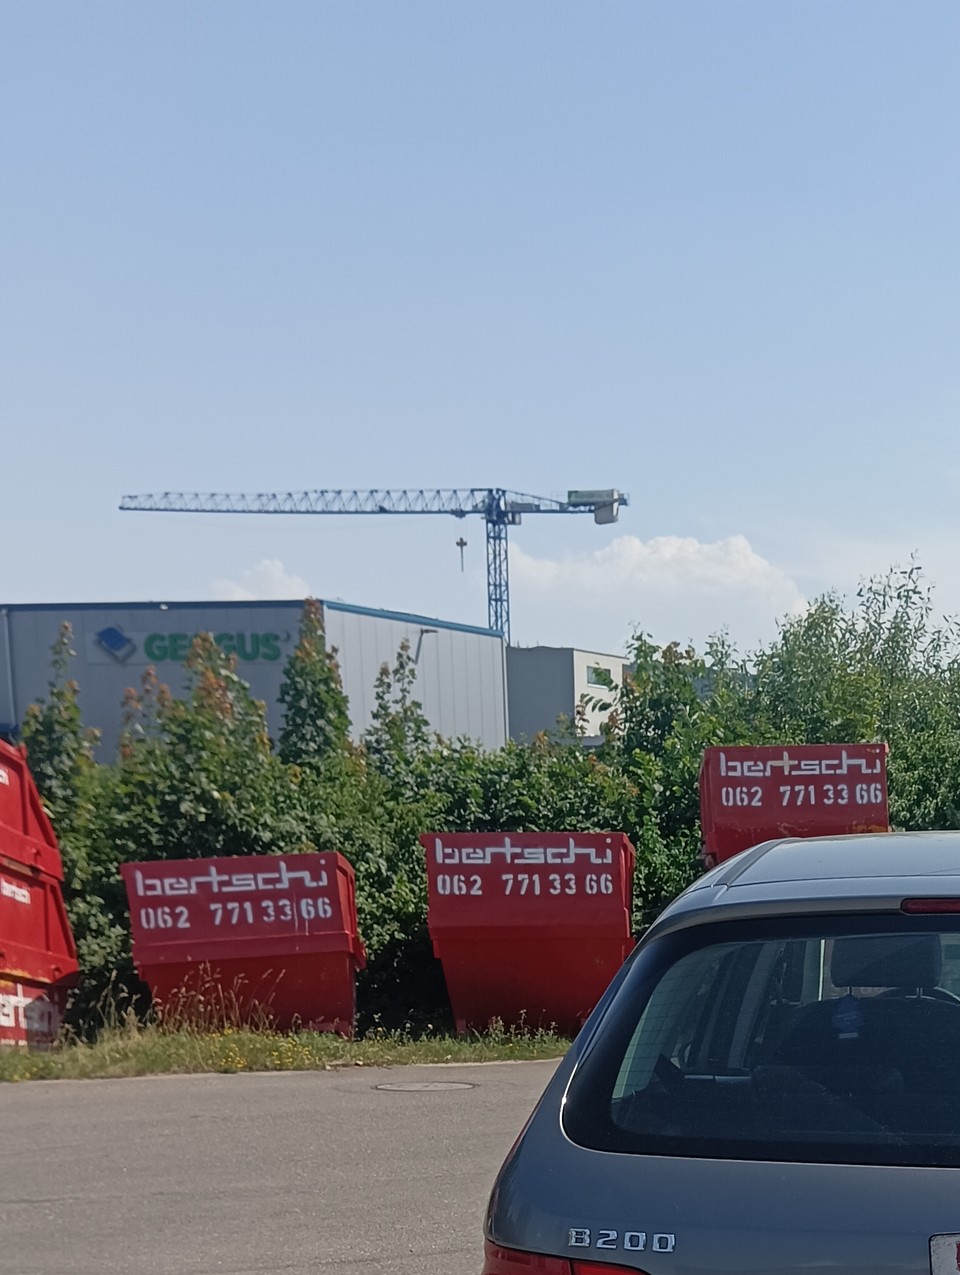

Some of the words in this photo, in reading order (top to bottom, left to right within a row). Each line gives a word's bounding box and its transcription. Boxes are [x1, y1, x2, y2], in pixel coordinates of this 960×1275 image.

[145, 633, 281, 661] GEGUS
[719, 749, 881, 777] bertschi
[721, 786, 763, 807] 062
[779, 785, 816, 807] 771
[822, 784, 849, 805] 33
[855, 783, 883, 804] 66
[435, 836, 613, 865] bertschi
[134, 858, 328, 897] bertschi
[436, 874, 483, 896] 062
[501, 873, 541, 896] 771
[548, 873, 577, 895] 33
[585, 873, 614, 895] 66
[140, 906, 191, 930] 062
[209, 901, 255, 926] 771
[260, 899, 293, 923] 33
[301, 897, 333, 920] 66
[567, 1228, 677, 1253] B200
